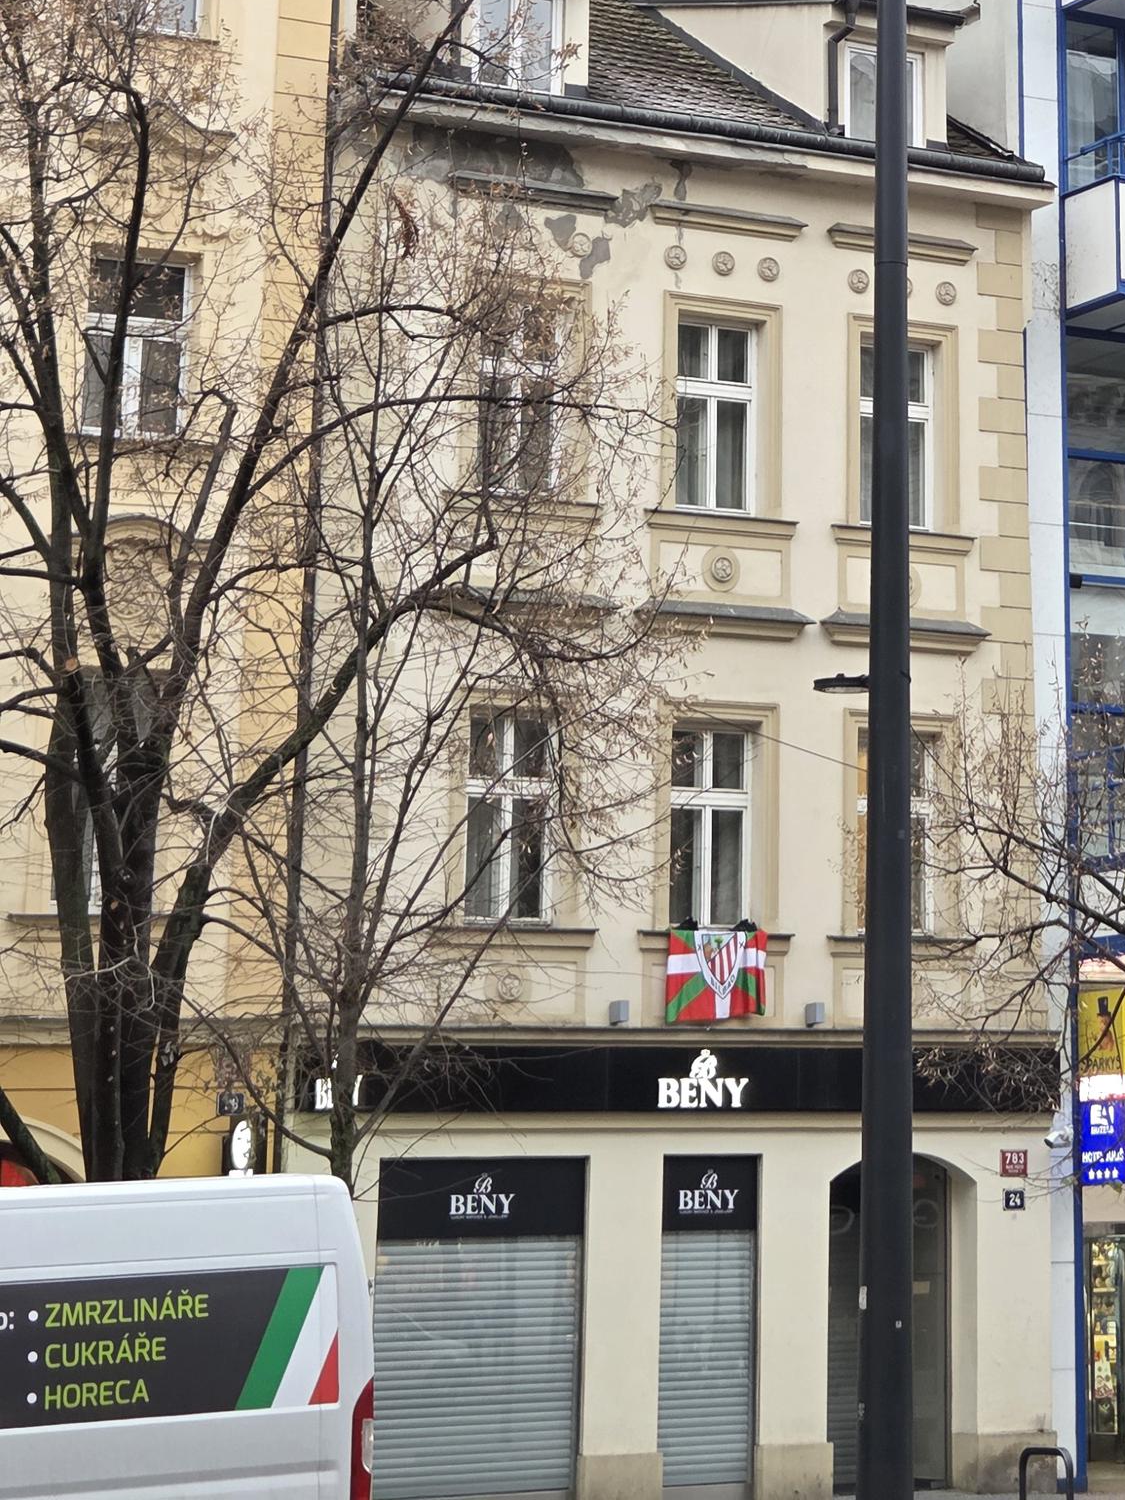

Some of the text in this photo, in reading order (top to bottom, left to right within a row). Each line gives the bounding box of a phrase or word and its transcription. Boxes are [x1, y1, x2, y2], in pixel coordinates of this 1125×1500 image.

[1079, 1055, 1121, 1071] SPARKYS
[657, 1077, 750, 1108] BENY
[1005, 1152, 1025, 1164] 783
[1081, 1150, 1105, 1164] HOTEL
[449, 1193, 516, 1215] BENY
[678, 1188, 740, 1210] BENY
[1008, 1193, 1021, 1207] 24
[45, 1288, 209, 1328] ZMRZLINÁŘE
[45, 1331, 167, 1369] CUKRÁŘE
[44, 1378, 150, 1411] HORECA
